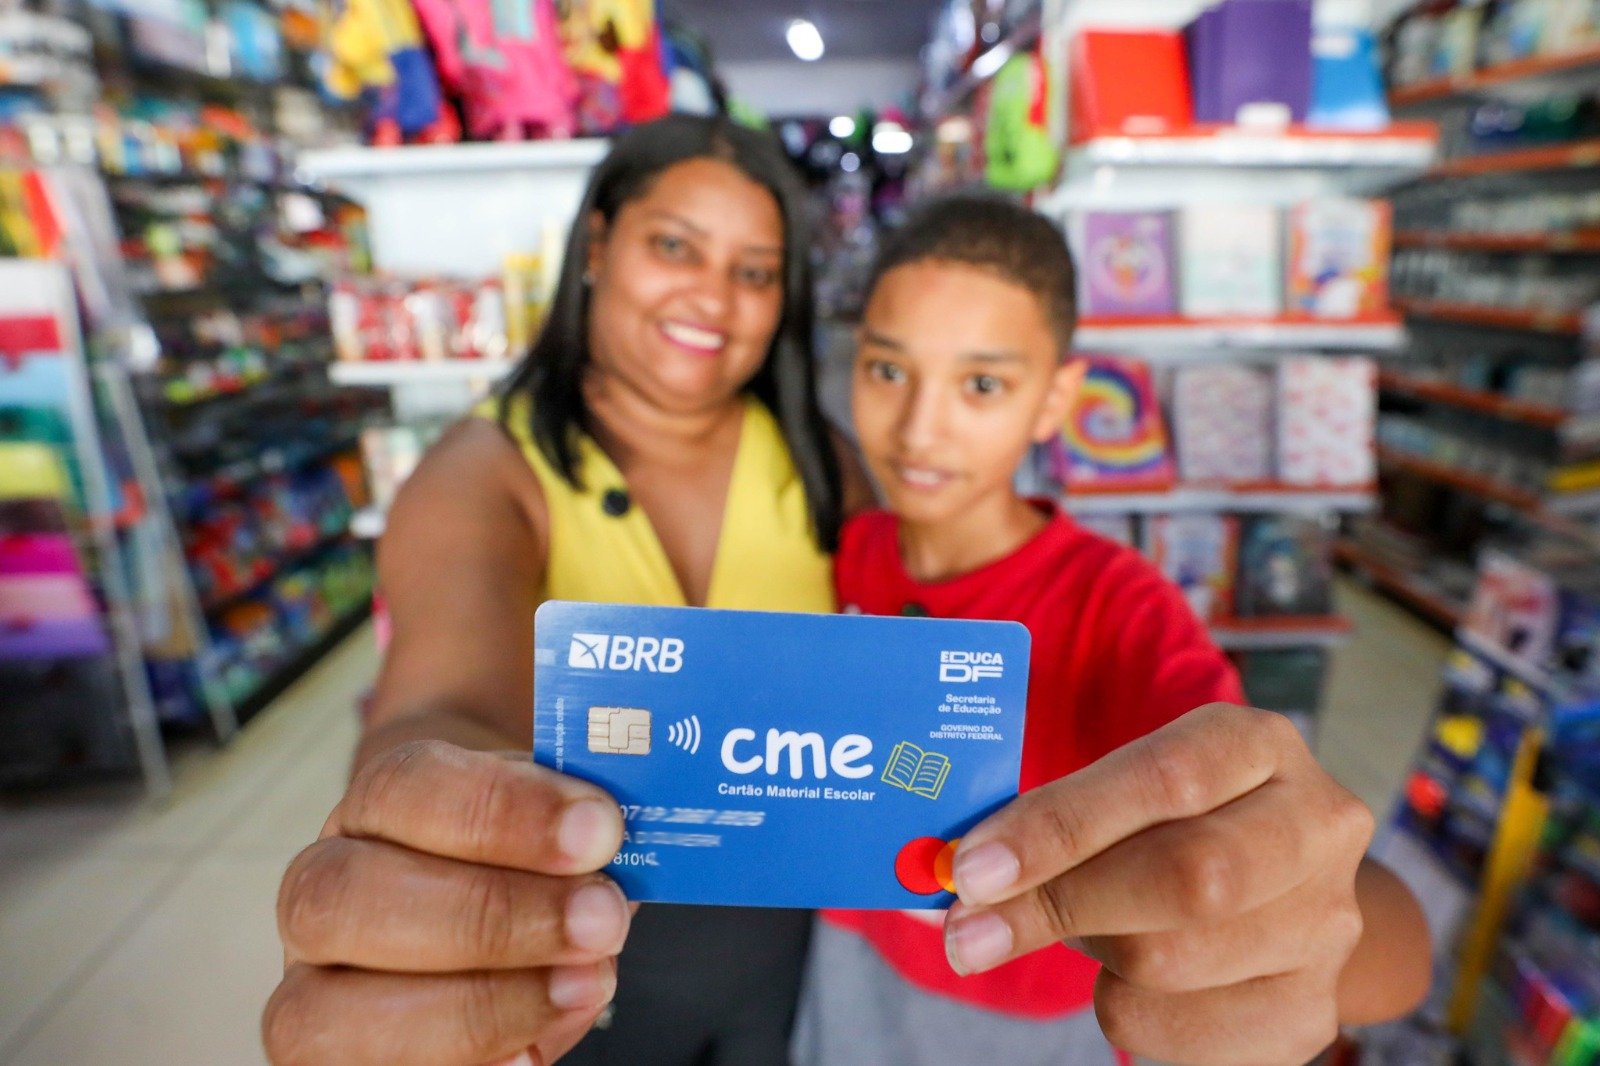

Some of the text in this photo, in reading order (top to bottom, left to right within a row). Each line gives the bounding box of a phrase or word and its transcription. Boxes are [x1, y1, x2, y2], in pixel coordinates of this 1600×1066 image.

[608, 635, 685, 674] BRB
[940, 650, 1004, 665] EDUCA
[939, 664, 1004, 682] DF
[945, 693, 996, 704] Secretaria
[938, 704, 1002, 716] de Educação
[929, 731, 1004, 741] DISTRITO FEDERAL
[940, 724, 994, 733] GOVERNO DO
[720, 727, 874, 780] cme
[717, 783, 876, 801] Cartão Material Escolar
